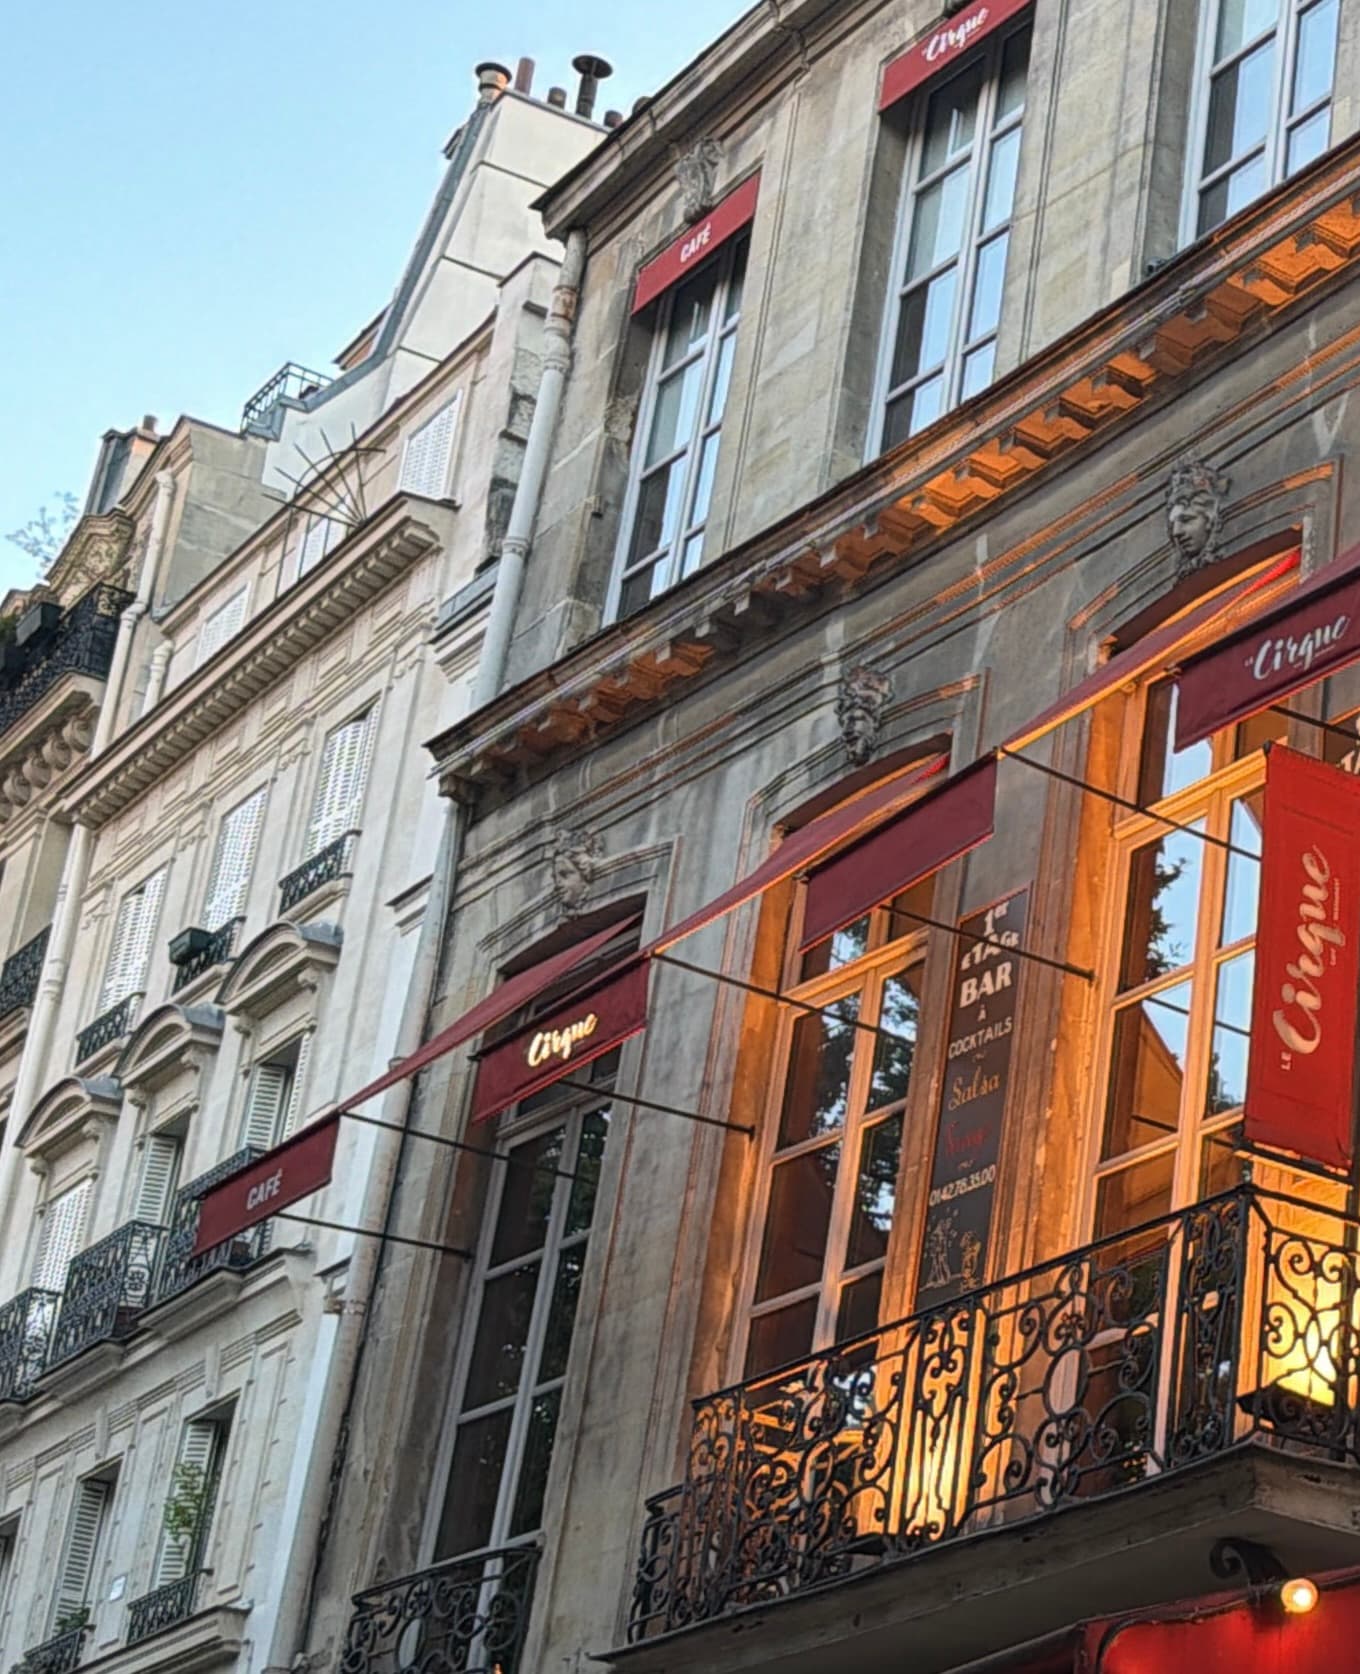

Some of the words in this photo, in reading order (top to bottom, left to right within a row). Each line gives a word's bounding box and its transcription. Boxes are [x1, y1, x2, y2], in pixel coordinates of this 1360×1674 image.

[927, 8, 989, 61] Cirque
[680, 221, 712, 263] CAFÉ
[1253, 615, 1351, 680] Cirque
[1273, 844, 1346, 1054] Cirque
[959, 961, 1013, 1009] BAR
[527, 1013, 599, 1068] Cirque
[948, 1016, 1013, 1060] COCKTAILS
[1280, 1052, 1293, 1071] LE
[948, 1065, 1000, 1111] Salsa
[246, 1167, 283, 1211] CAFÉ
